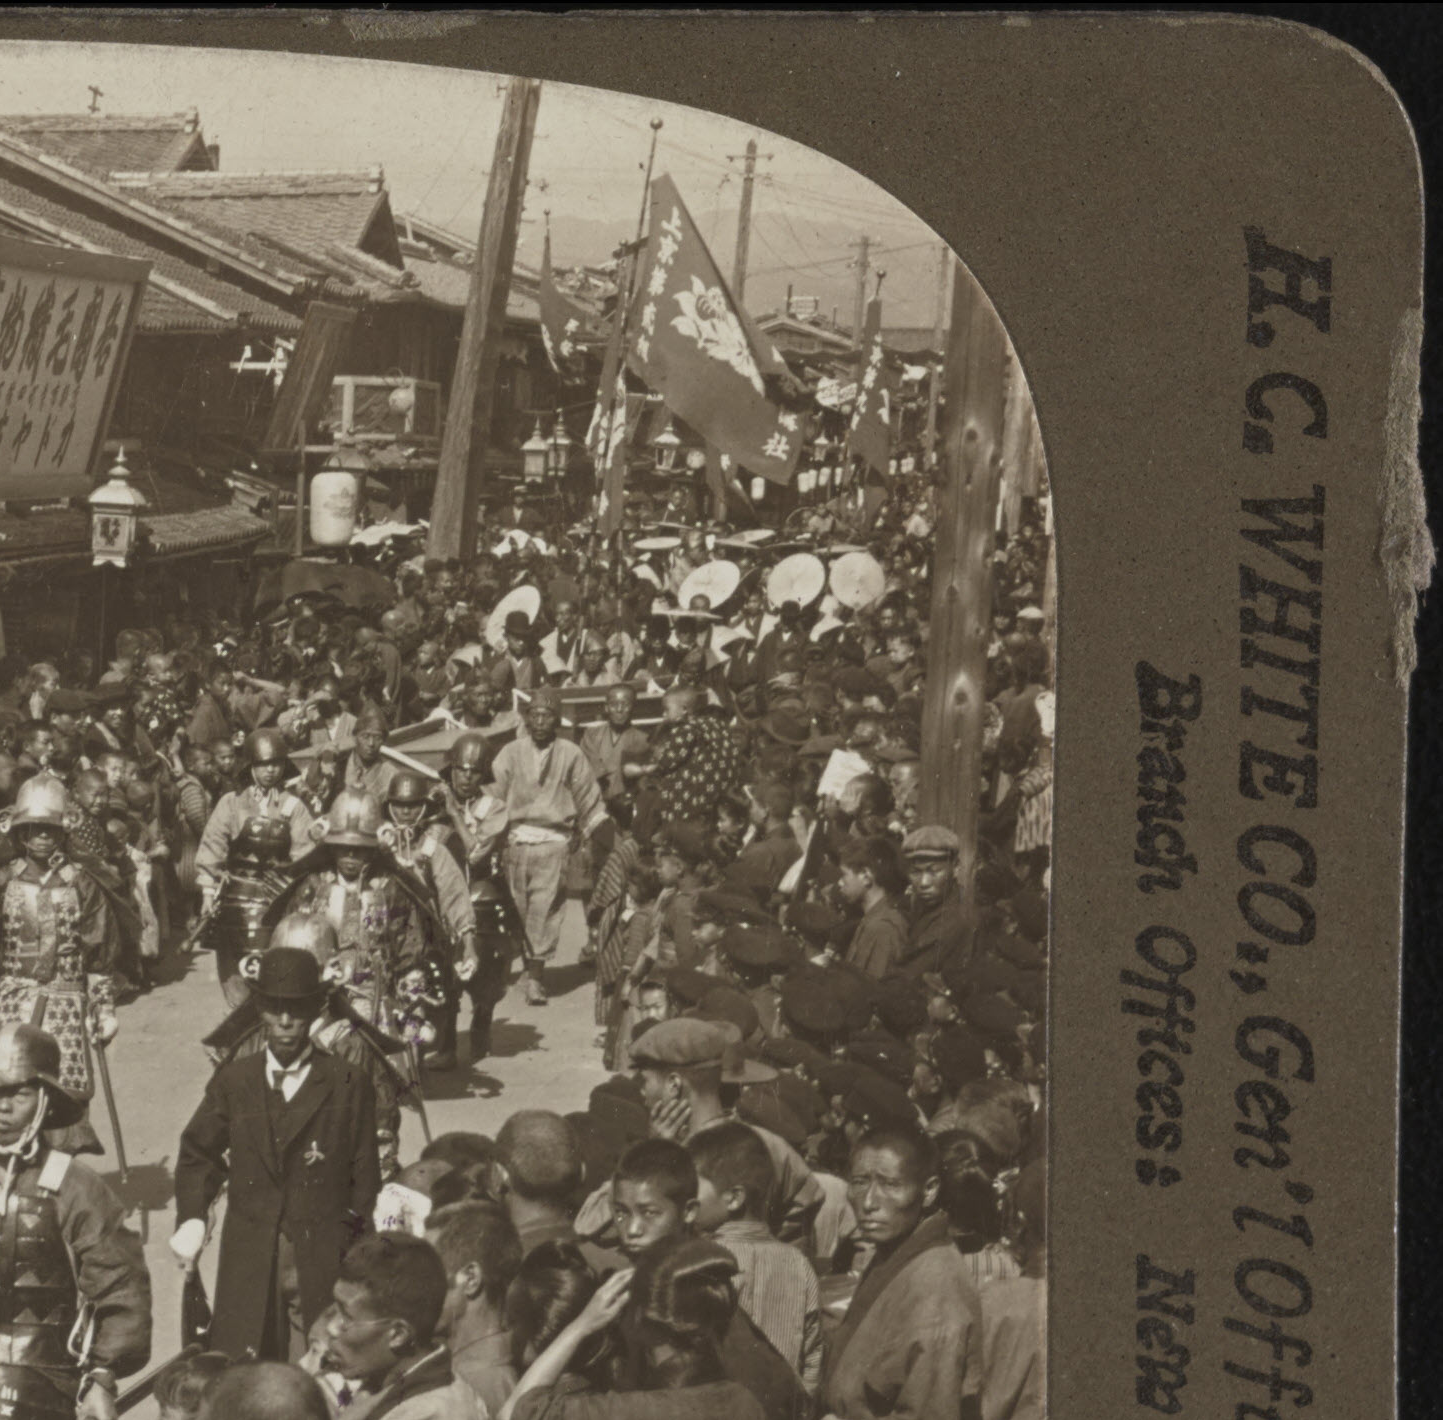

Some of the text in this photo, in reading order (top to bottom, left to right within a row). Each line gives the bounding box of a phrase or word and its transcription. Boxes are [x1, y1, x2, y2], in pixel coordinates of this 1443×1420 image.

[1243, 226, 1333, 348] H.
[1242, 372, 1328, 454] C.
[1238, 484, 1326, 809] WHITE
[1134, 660, 1203, 894] Branch
[1120, 926, 1198, 1187] Offices:
[1136, 1254, 1197, 1415] New
